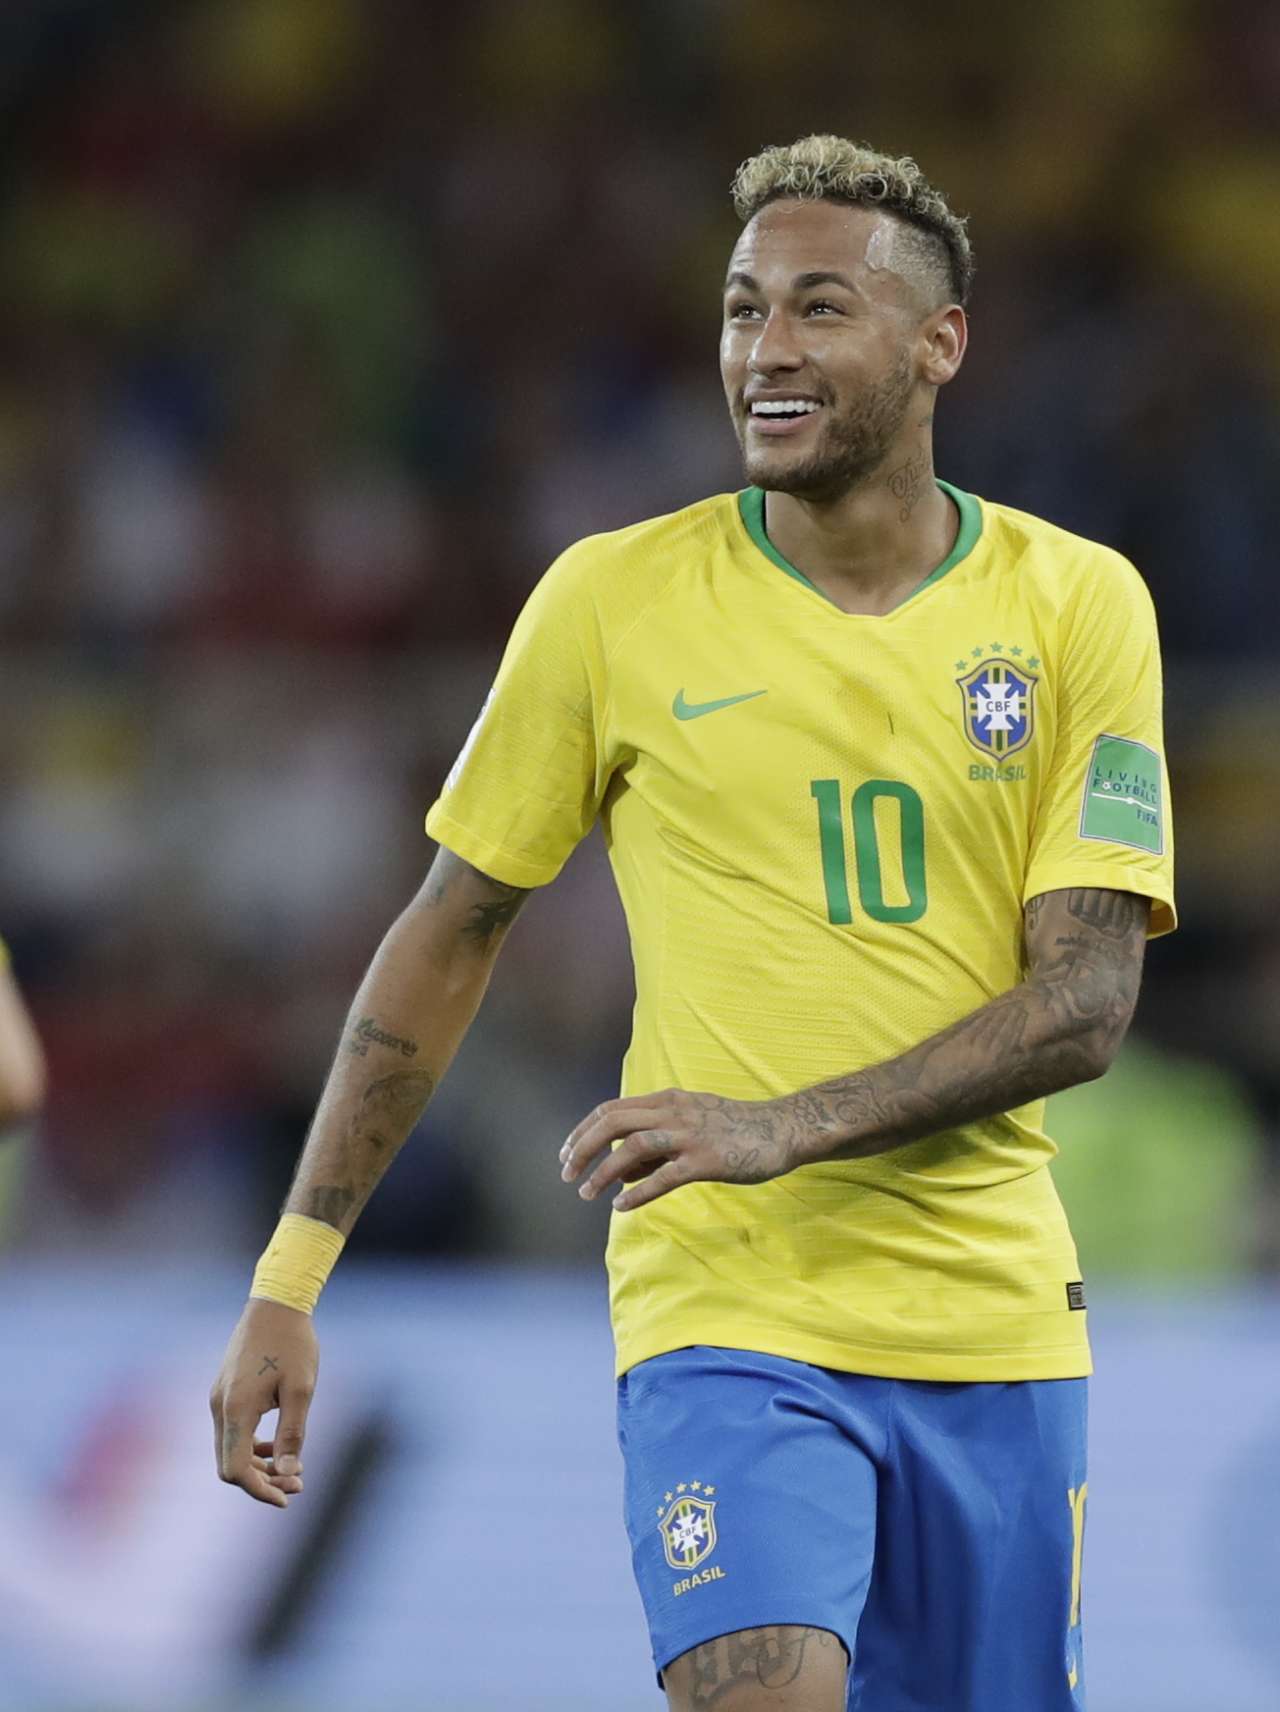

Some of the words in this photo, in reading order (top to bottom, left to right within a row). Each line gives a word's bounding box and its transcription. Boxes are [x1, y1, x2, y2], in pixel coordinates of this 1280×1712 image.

[986, 701, 1011, 712] CBF
[968, 764, 1027, 782] BRASIL
[1137, 809, 1158, 826] FIFA
[810, 779, 928, 924] 10
[673, 1566, 726, 1597] BRASIL
